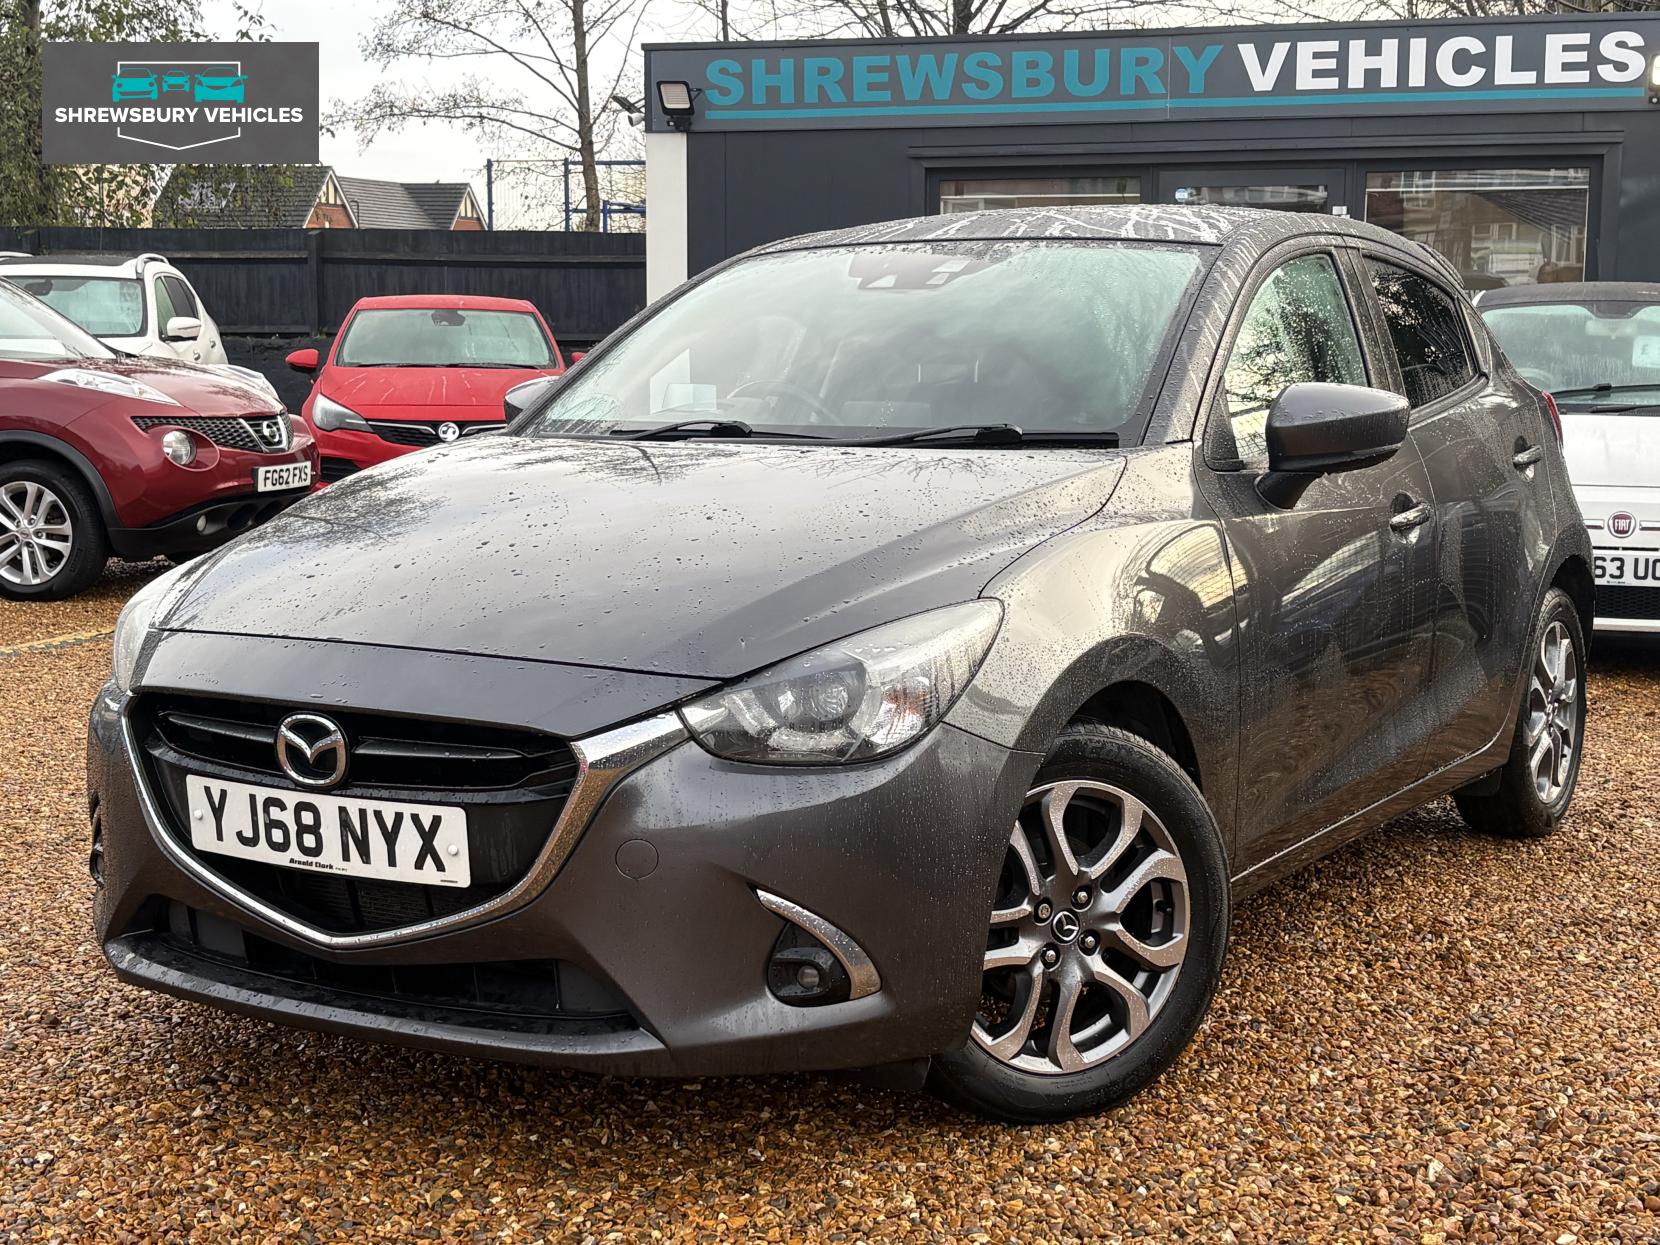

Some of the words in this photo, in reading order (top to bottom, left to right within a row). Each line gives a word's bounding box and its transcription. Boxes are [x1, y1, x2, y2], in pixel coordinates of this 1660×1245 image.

[705, 45, 1224, 105] SHREWSBURY
[1237, 31, 1647, 92] VEHICLES
[263, 467, 291, 487] FG62
[292, 464, 308, 484] FXS
[1614, 518, 1631, 531] FIAT
[203, 785, 324, 858] YJ68
[337, 805, 446, 872] NYX
[314, 861, 334, 870] Clark
